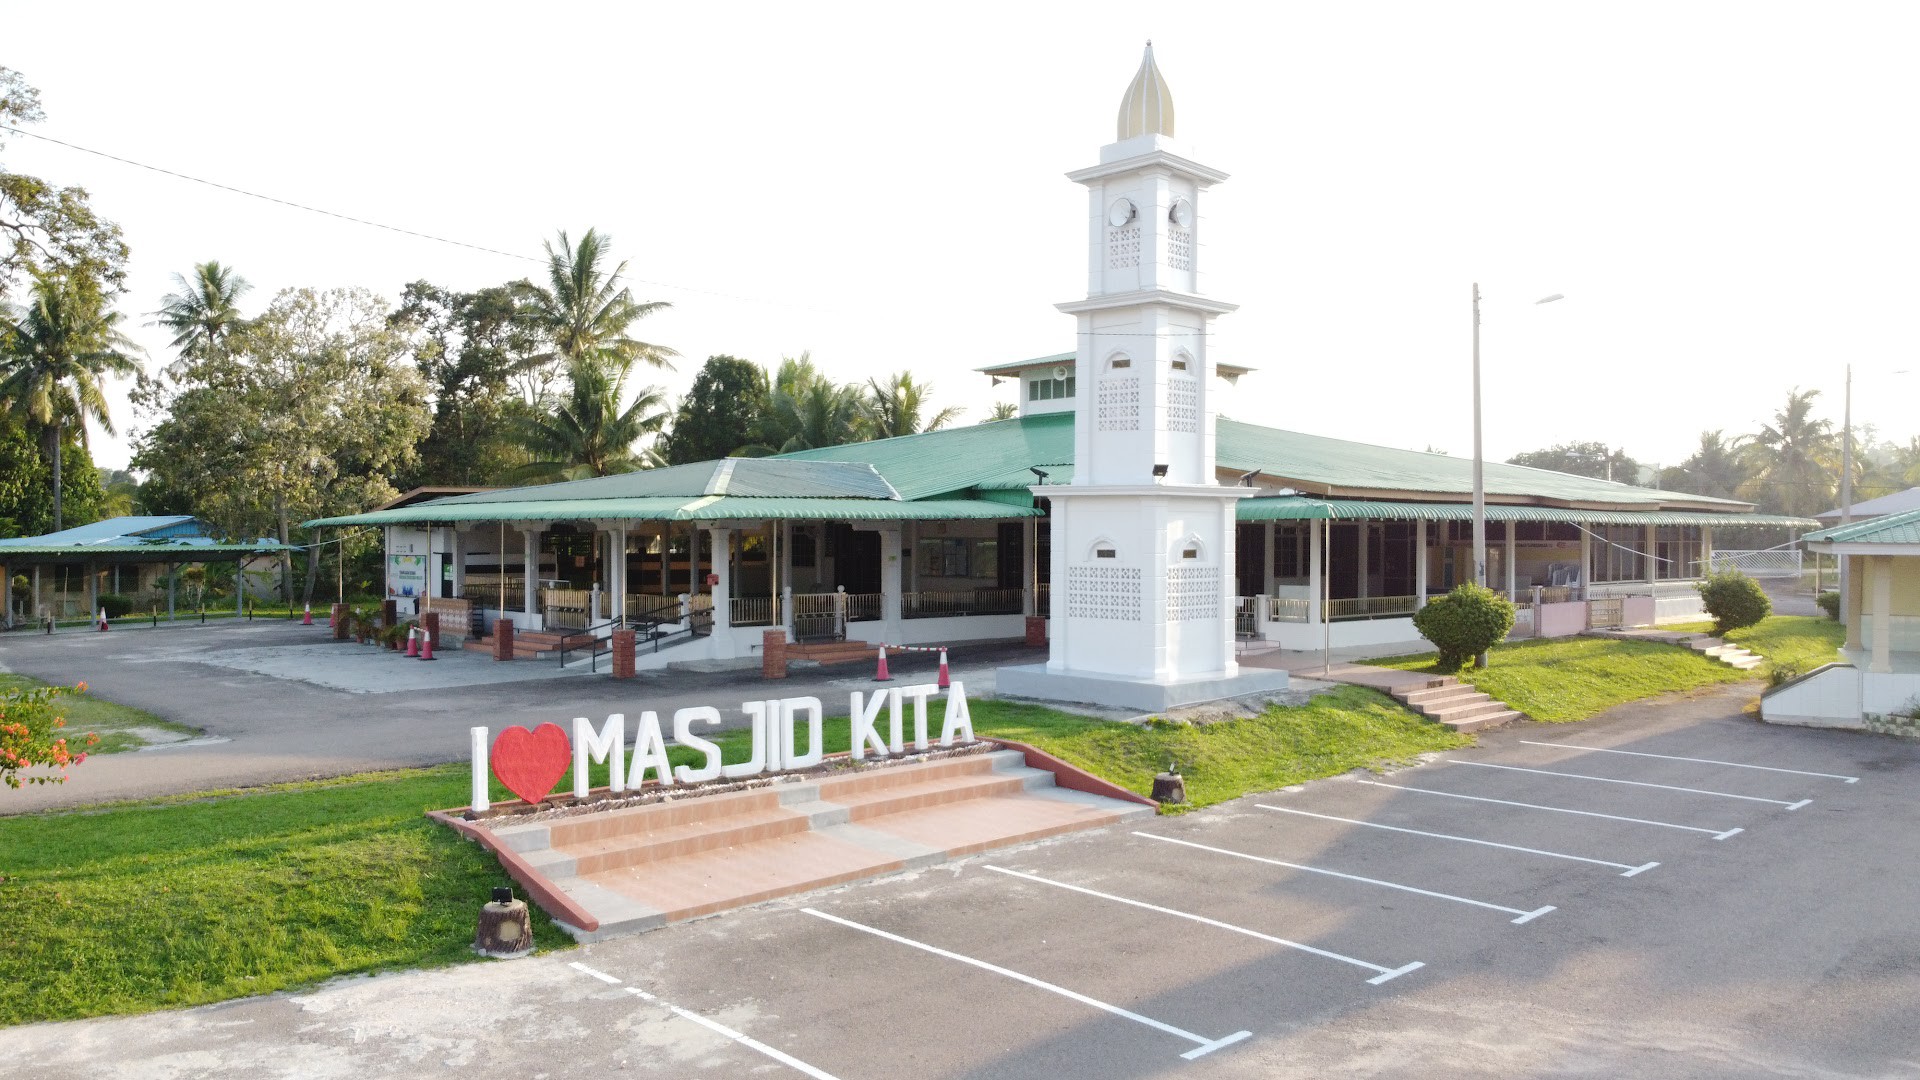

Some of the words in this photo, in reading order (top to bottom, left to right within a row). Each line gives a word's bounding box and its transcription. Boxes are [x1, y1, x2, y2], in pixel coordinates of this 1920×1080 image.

[471, 726, 489, 813] I
[573, 696, 823, 798] MASJID
[849, 680, 976, 760] KITA
